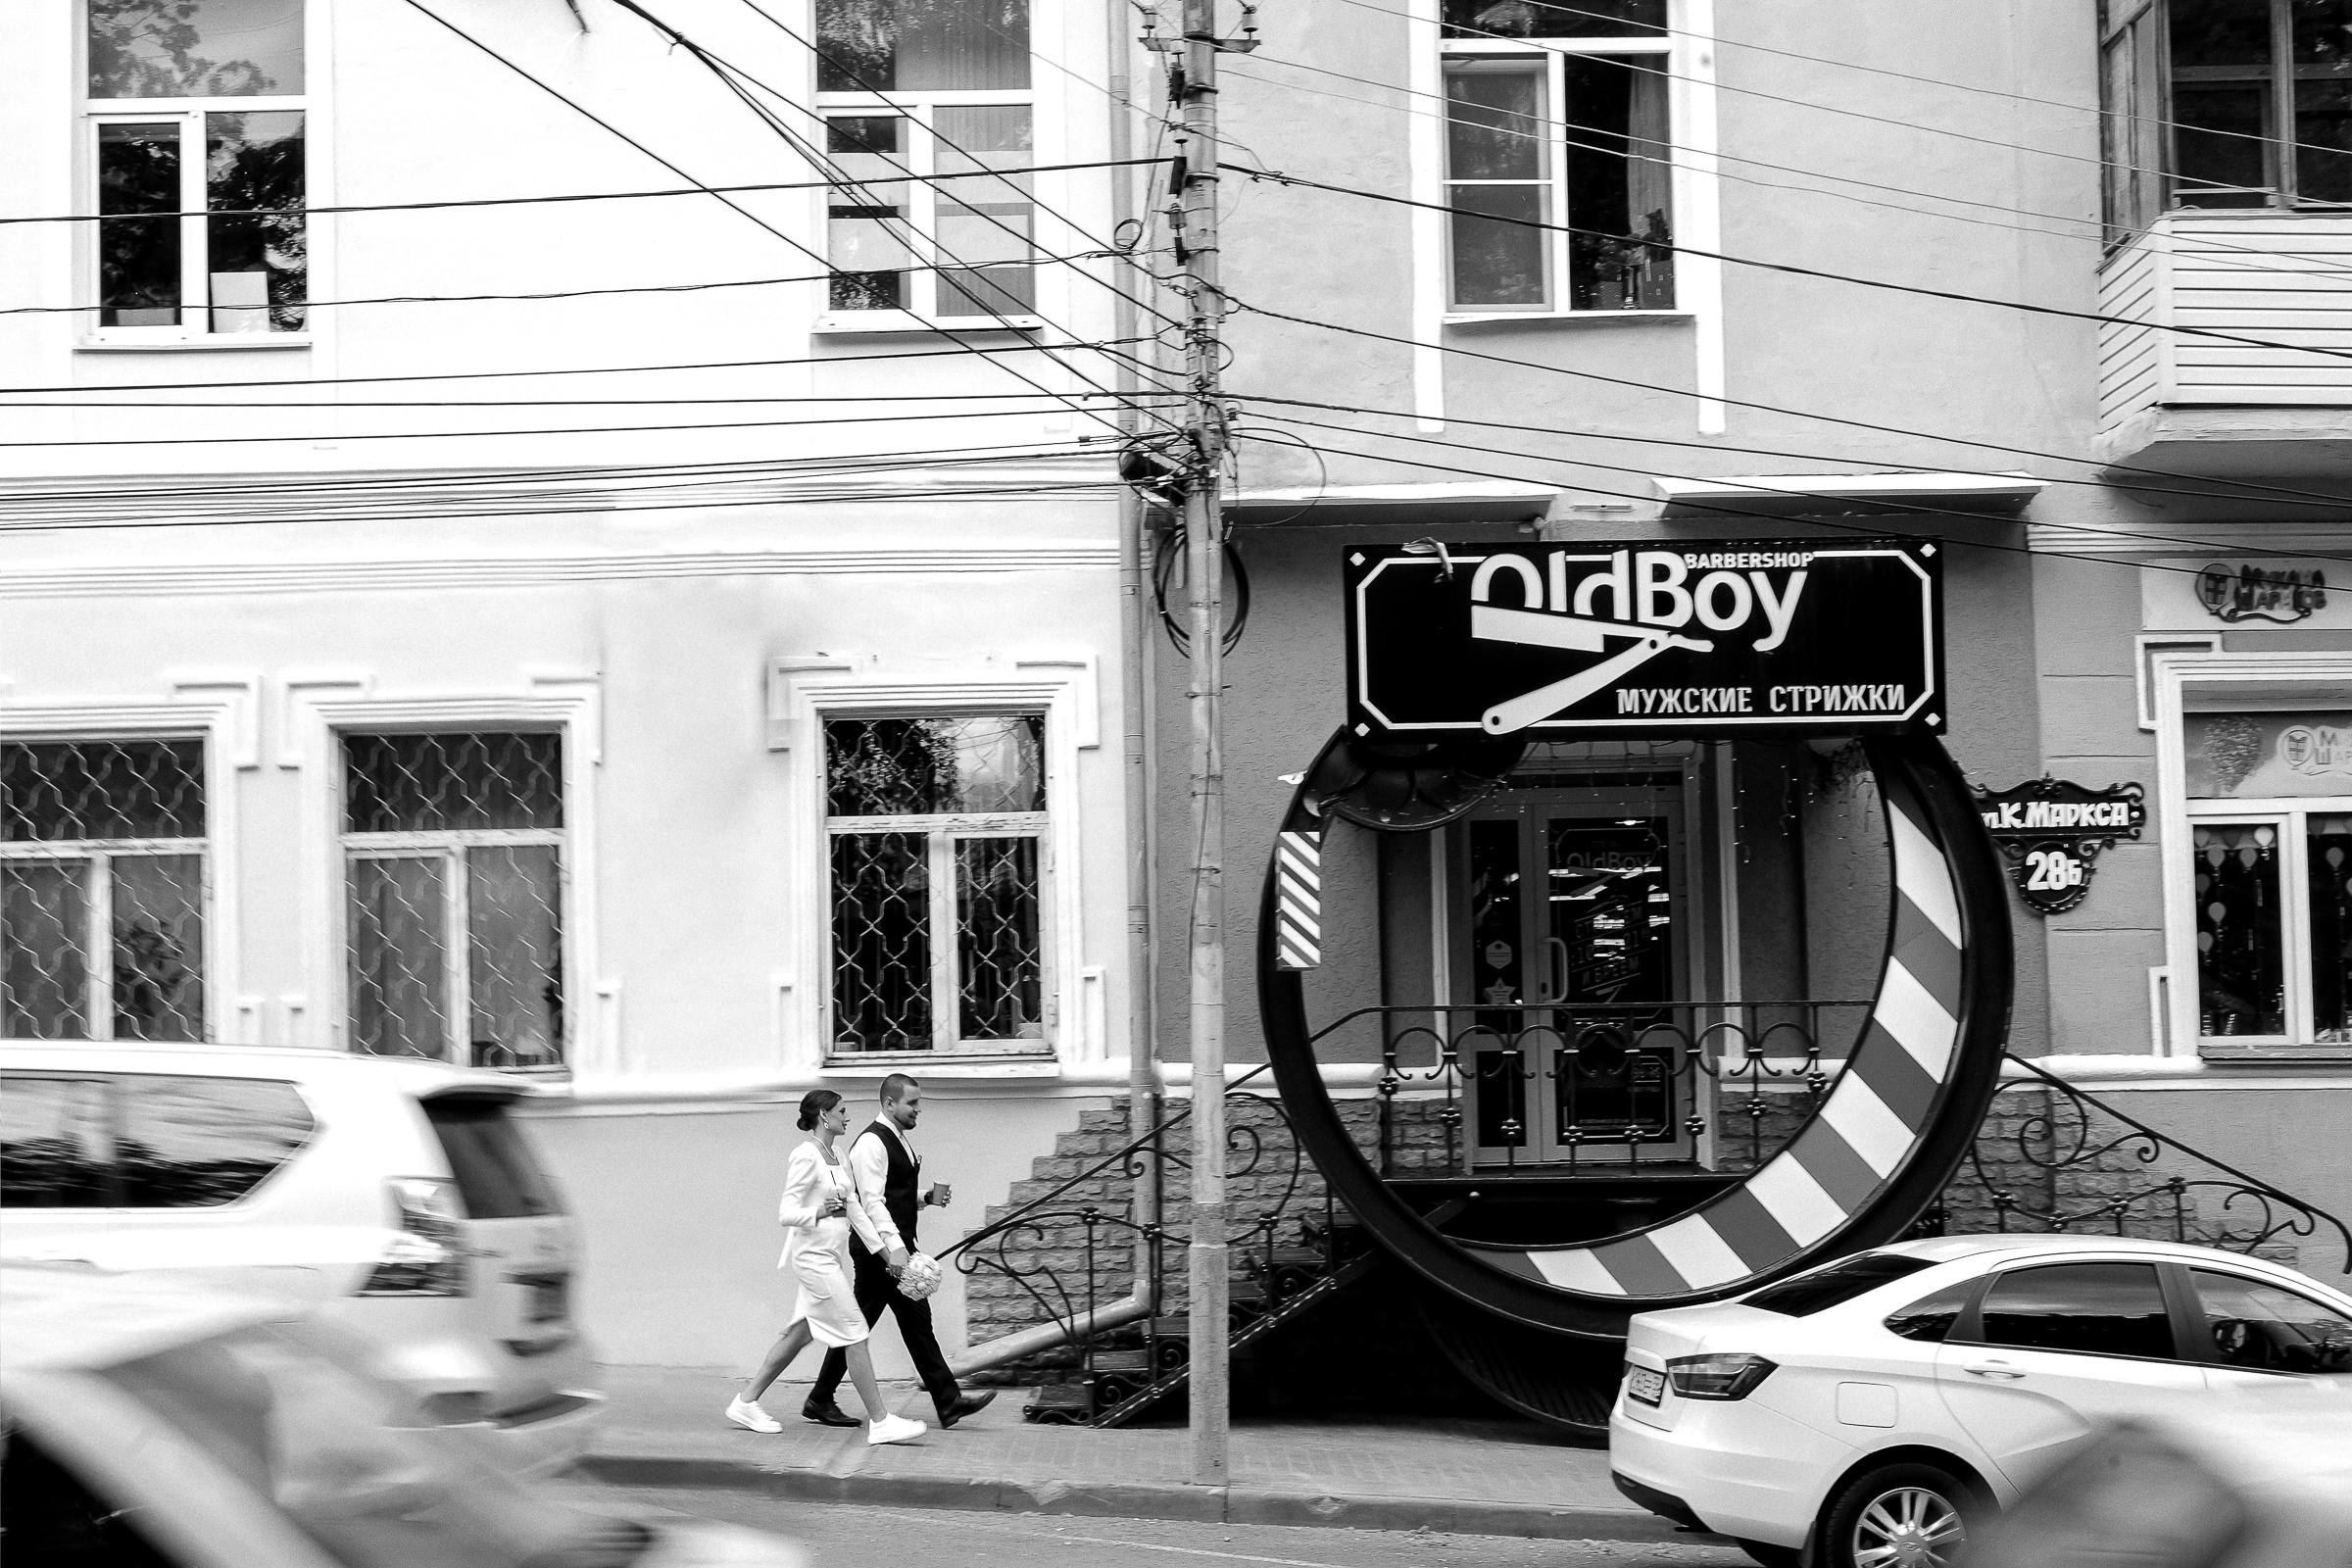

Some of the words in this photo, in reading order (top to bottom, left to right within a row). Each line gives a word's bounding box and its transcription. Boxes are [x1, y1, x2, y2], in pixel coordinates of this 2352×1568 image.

[1684, 552, 1814, 569] BARBERSHOP
[1471, 549, 1808, 652] OldBoy
[1618, 686, 1752, 714] МУЖСКИЕ
[1770, 684, 1905, 712] СТРИЖКИ
